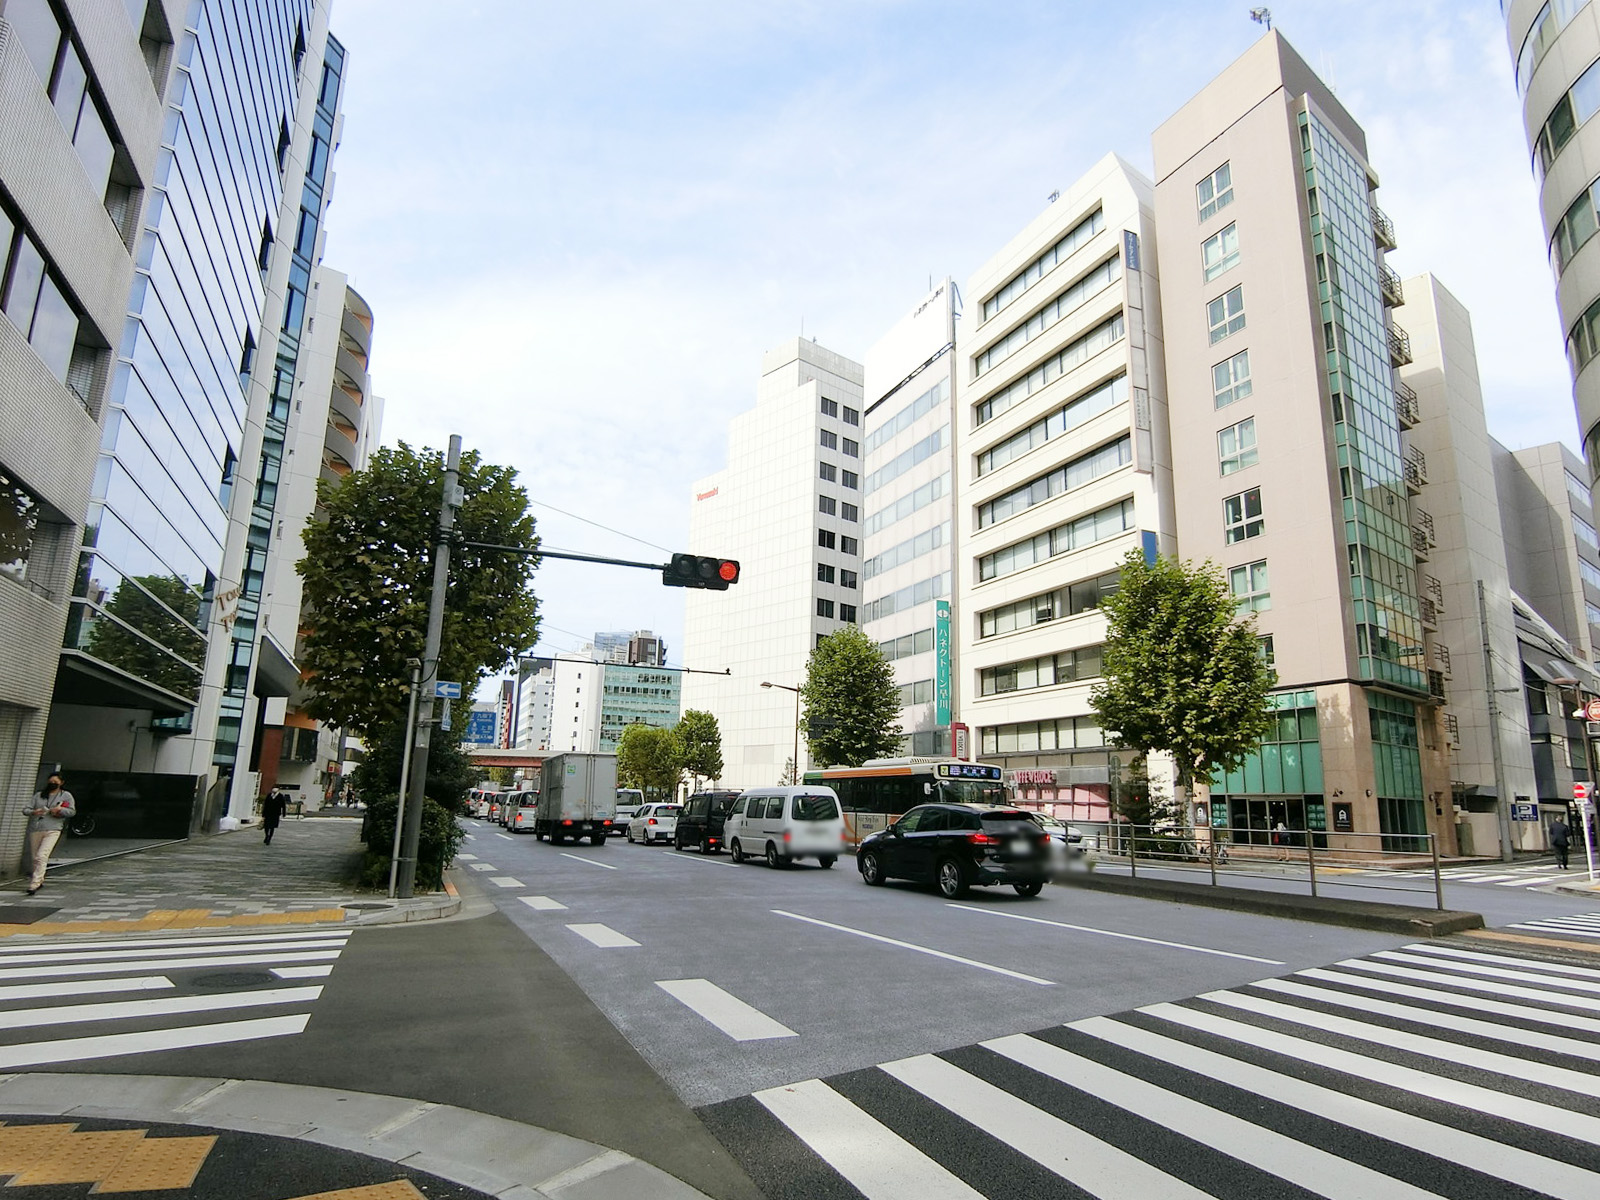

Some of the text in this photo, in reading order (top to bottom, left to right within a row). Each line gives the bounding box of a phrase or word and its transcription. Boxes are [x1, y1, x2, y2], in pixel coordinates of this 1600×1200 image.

[939, 628, 948, 710] ハネクトーン早川
